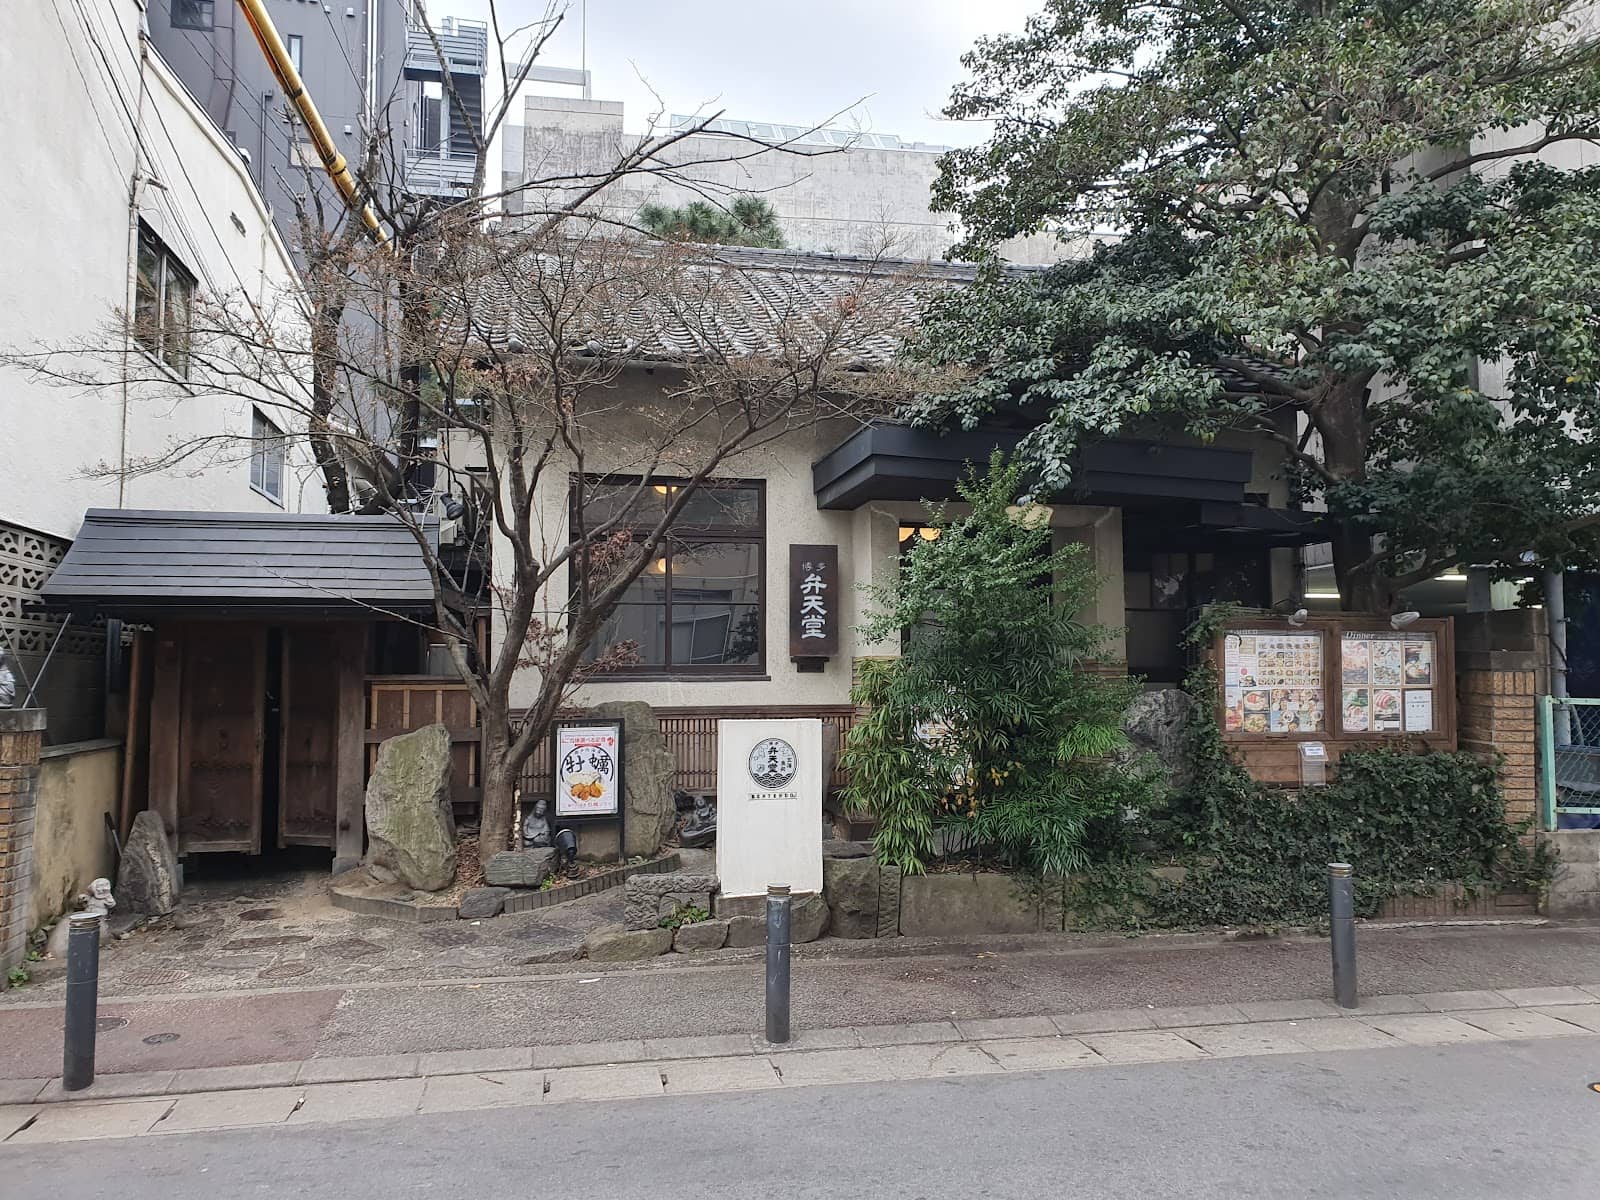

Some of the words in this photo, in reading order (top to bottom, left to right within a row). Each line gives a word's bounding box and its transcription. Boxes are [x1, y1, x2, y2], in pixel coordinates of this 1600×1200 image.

[802, 561, 826, 572] 博多
[800, 573, 827, 639] 弁天堂
[1345, 631, 1375, 640] Dinner
[566, 753, 611, 774] 牡蠣
[768, 746, 778, 773] 弁天堂
